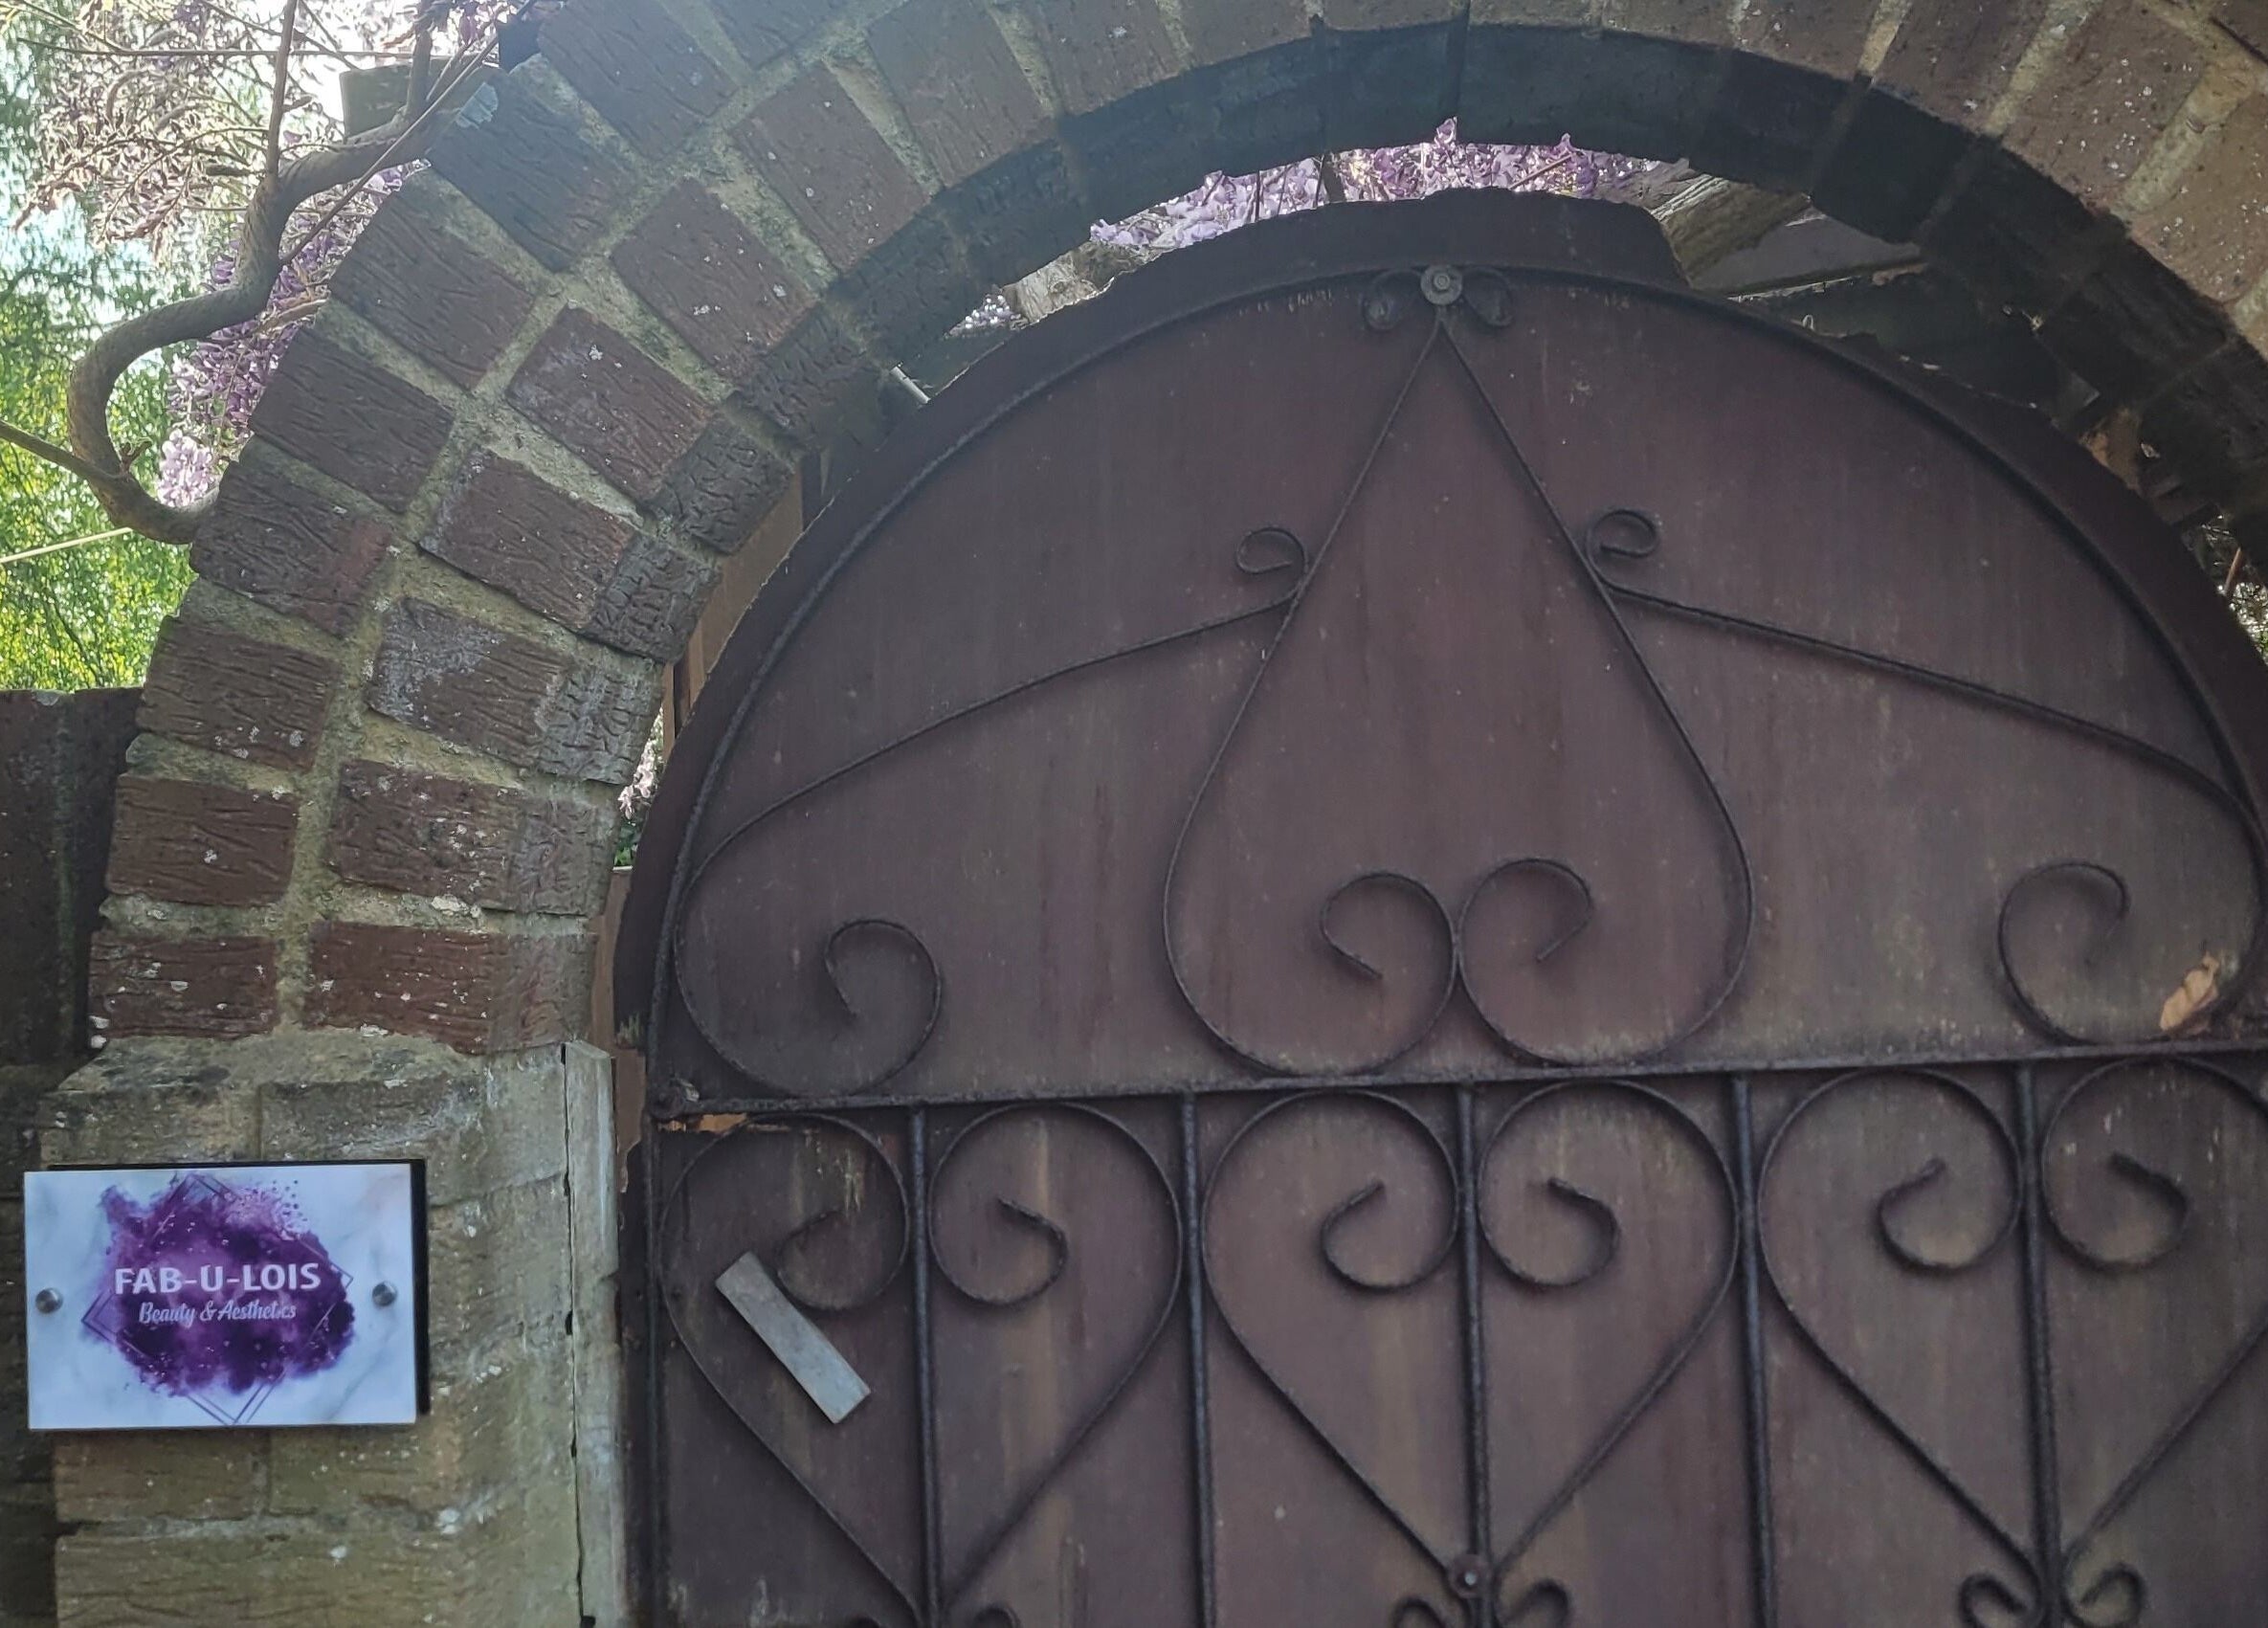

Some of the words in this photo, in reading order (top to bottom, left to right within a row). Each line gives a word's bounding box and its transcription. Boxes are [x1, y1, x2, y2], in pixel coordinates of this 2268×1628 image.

[115, 1262, 322, 1294] FAB-U-LOIS
[139, 1301, 195, 1327] Beauty
[199, 1300, 216, 1322] &
[217, 1299, 297, 1322] Aesthetics
